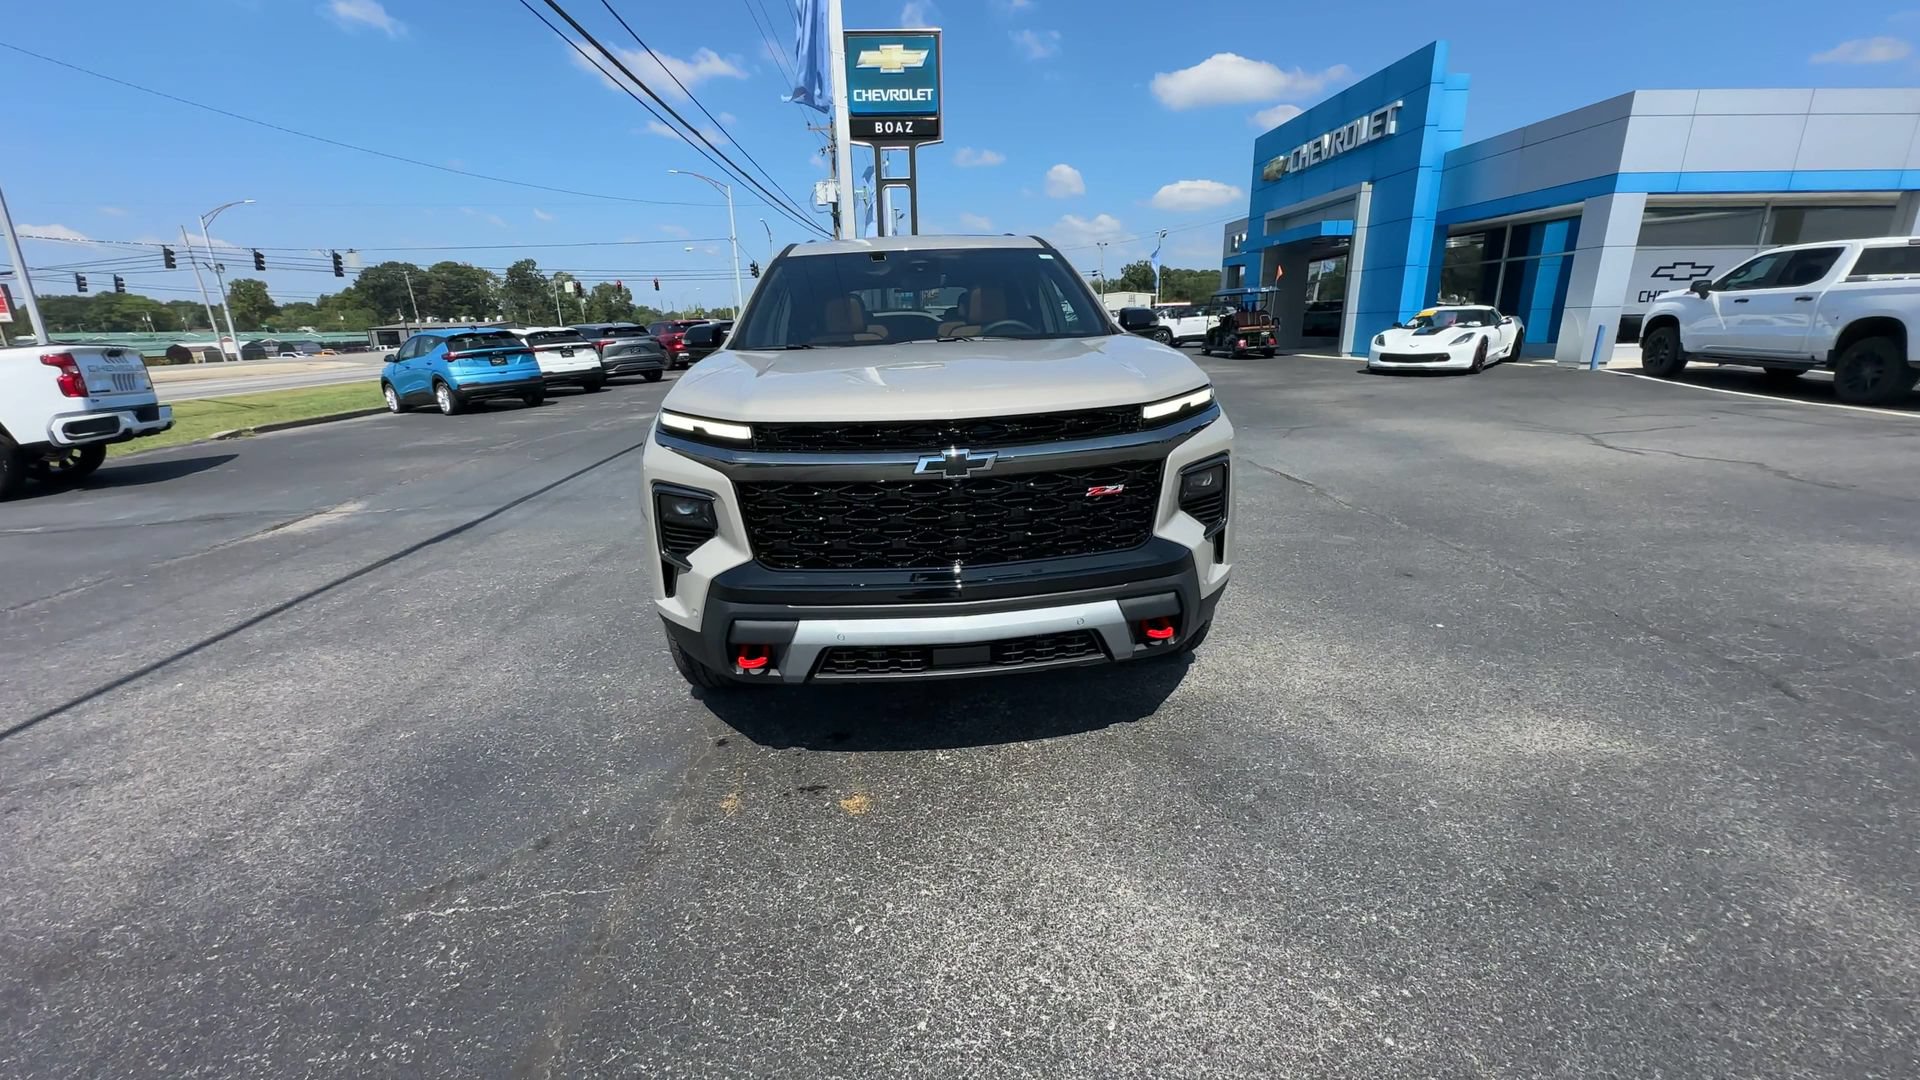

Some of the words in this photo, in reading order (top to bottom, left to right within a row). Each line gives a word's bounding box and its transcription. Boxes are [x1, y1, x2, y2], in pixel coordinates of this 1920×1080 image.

[853, 88, 934, 102] CHEVROLET
[875, 121, 914, 134] BOAZ
[1290, 100, 1404, 173] CHEVROLET
